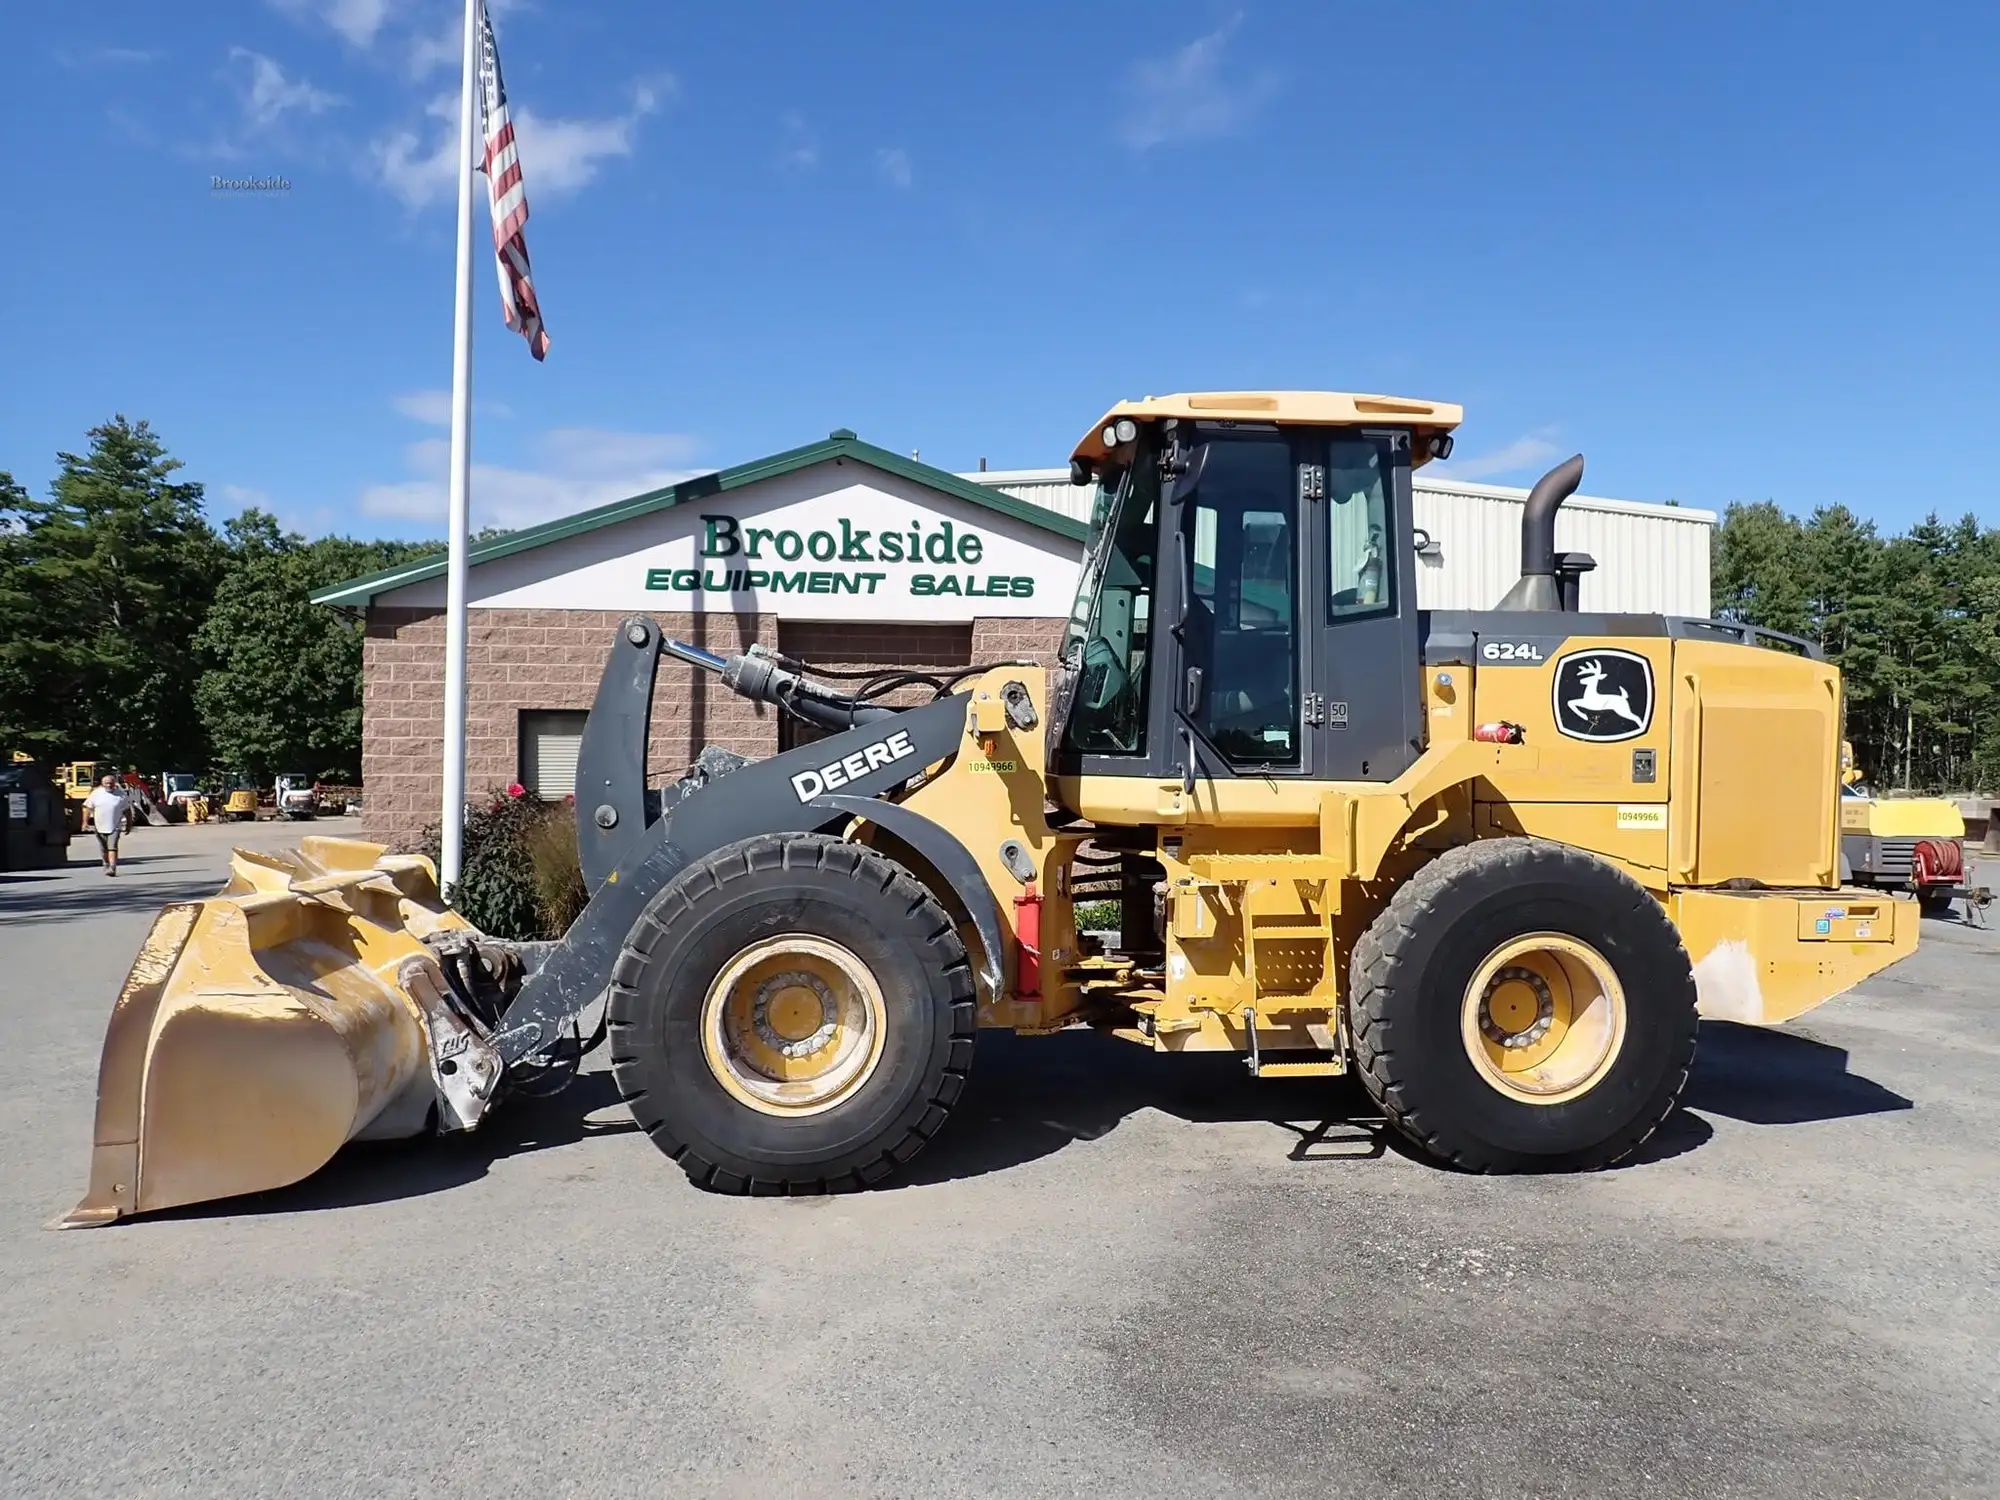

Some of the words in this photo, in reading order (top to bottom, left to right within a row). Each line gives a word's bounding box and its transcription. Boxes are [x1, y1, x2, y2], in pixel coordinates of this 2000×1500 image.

[700, 514, 983, 563] Brookside
[645, 568, 886, 594] EQUIPMENT
[909, 573, 1035, 598] SALES
[1482, 643, 1543, 660] 624L
[1331, 703, 1347, 716] 50
[791, 730, 916, 803] DEERE
[968, 761, 1013, 772] 10949966
[1617, 811, 1659, 821] 10949966
